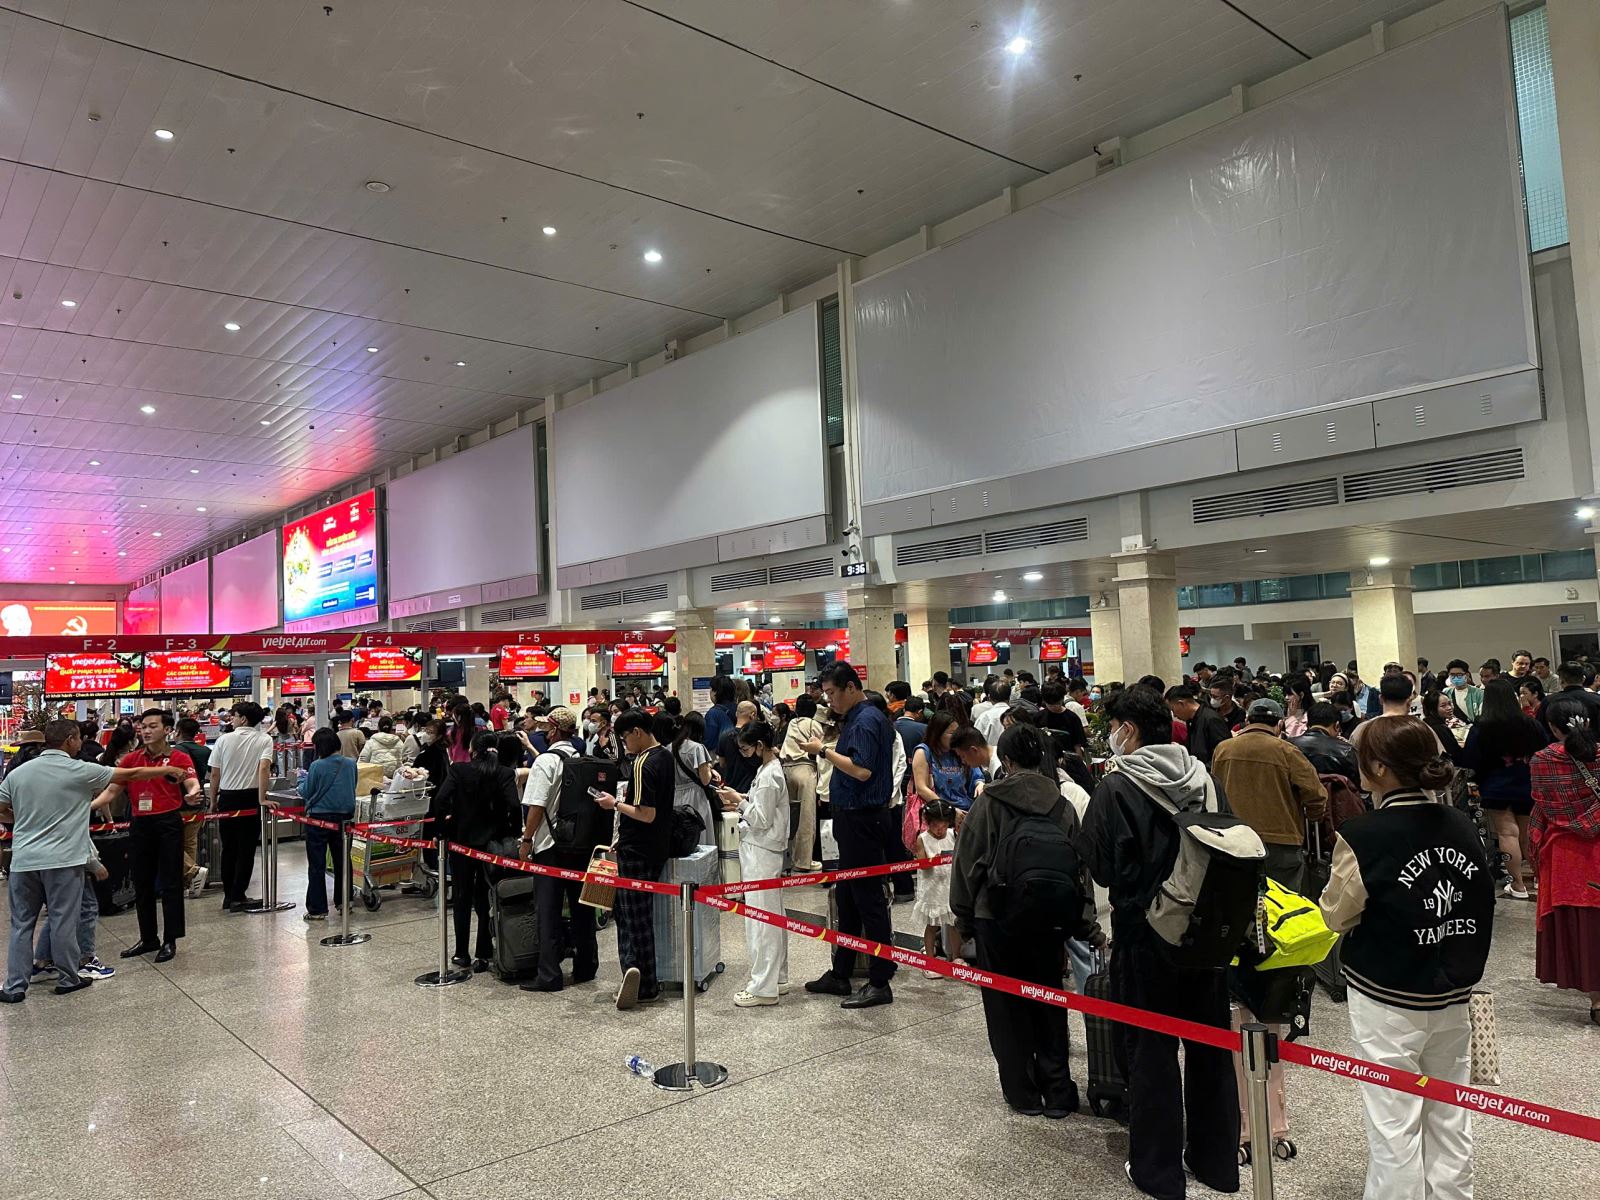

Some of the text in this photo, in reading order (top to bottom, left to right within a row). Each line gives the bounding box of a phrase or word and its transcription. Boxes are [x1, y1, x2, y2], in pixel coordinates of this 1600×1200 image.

[847, 564, 865, 575] 9:36
[1397, 846, 1479, 889] NEW YORK
[1413, 918, 1477, 945] YANEES
